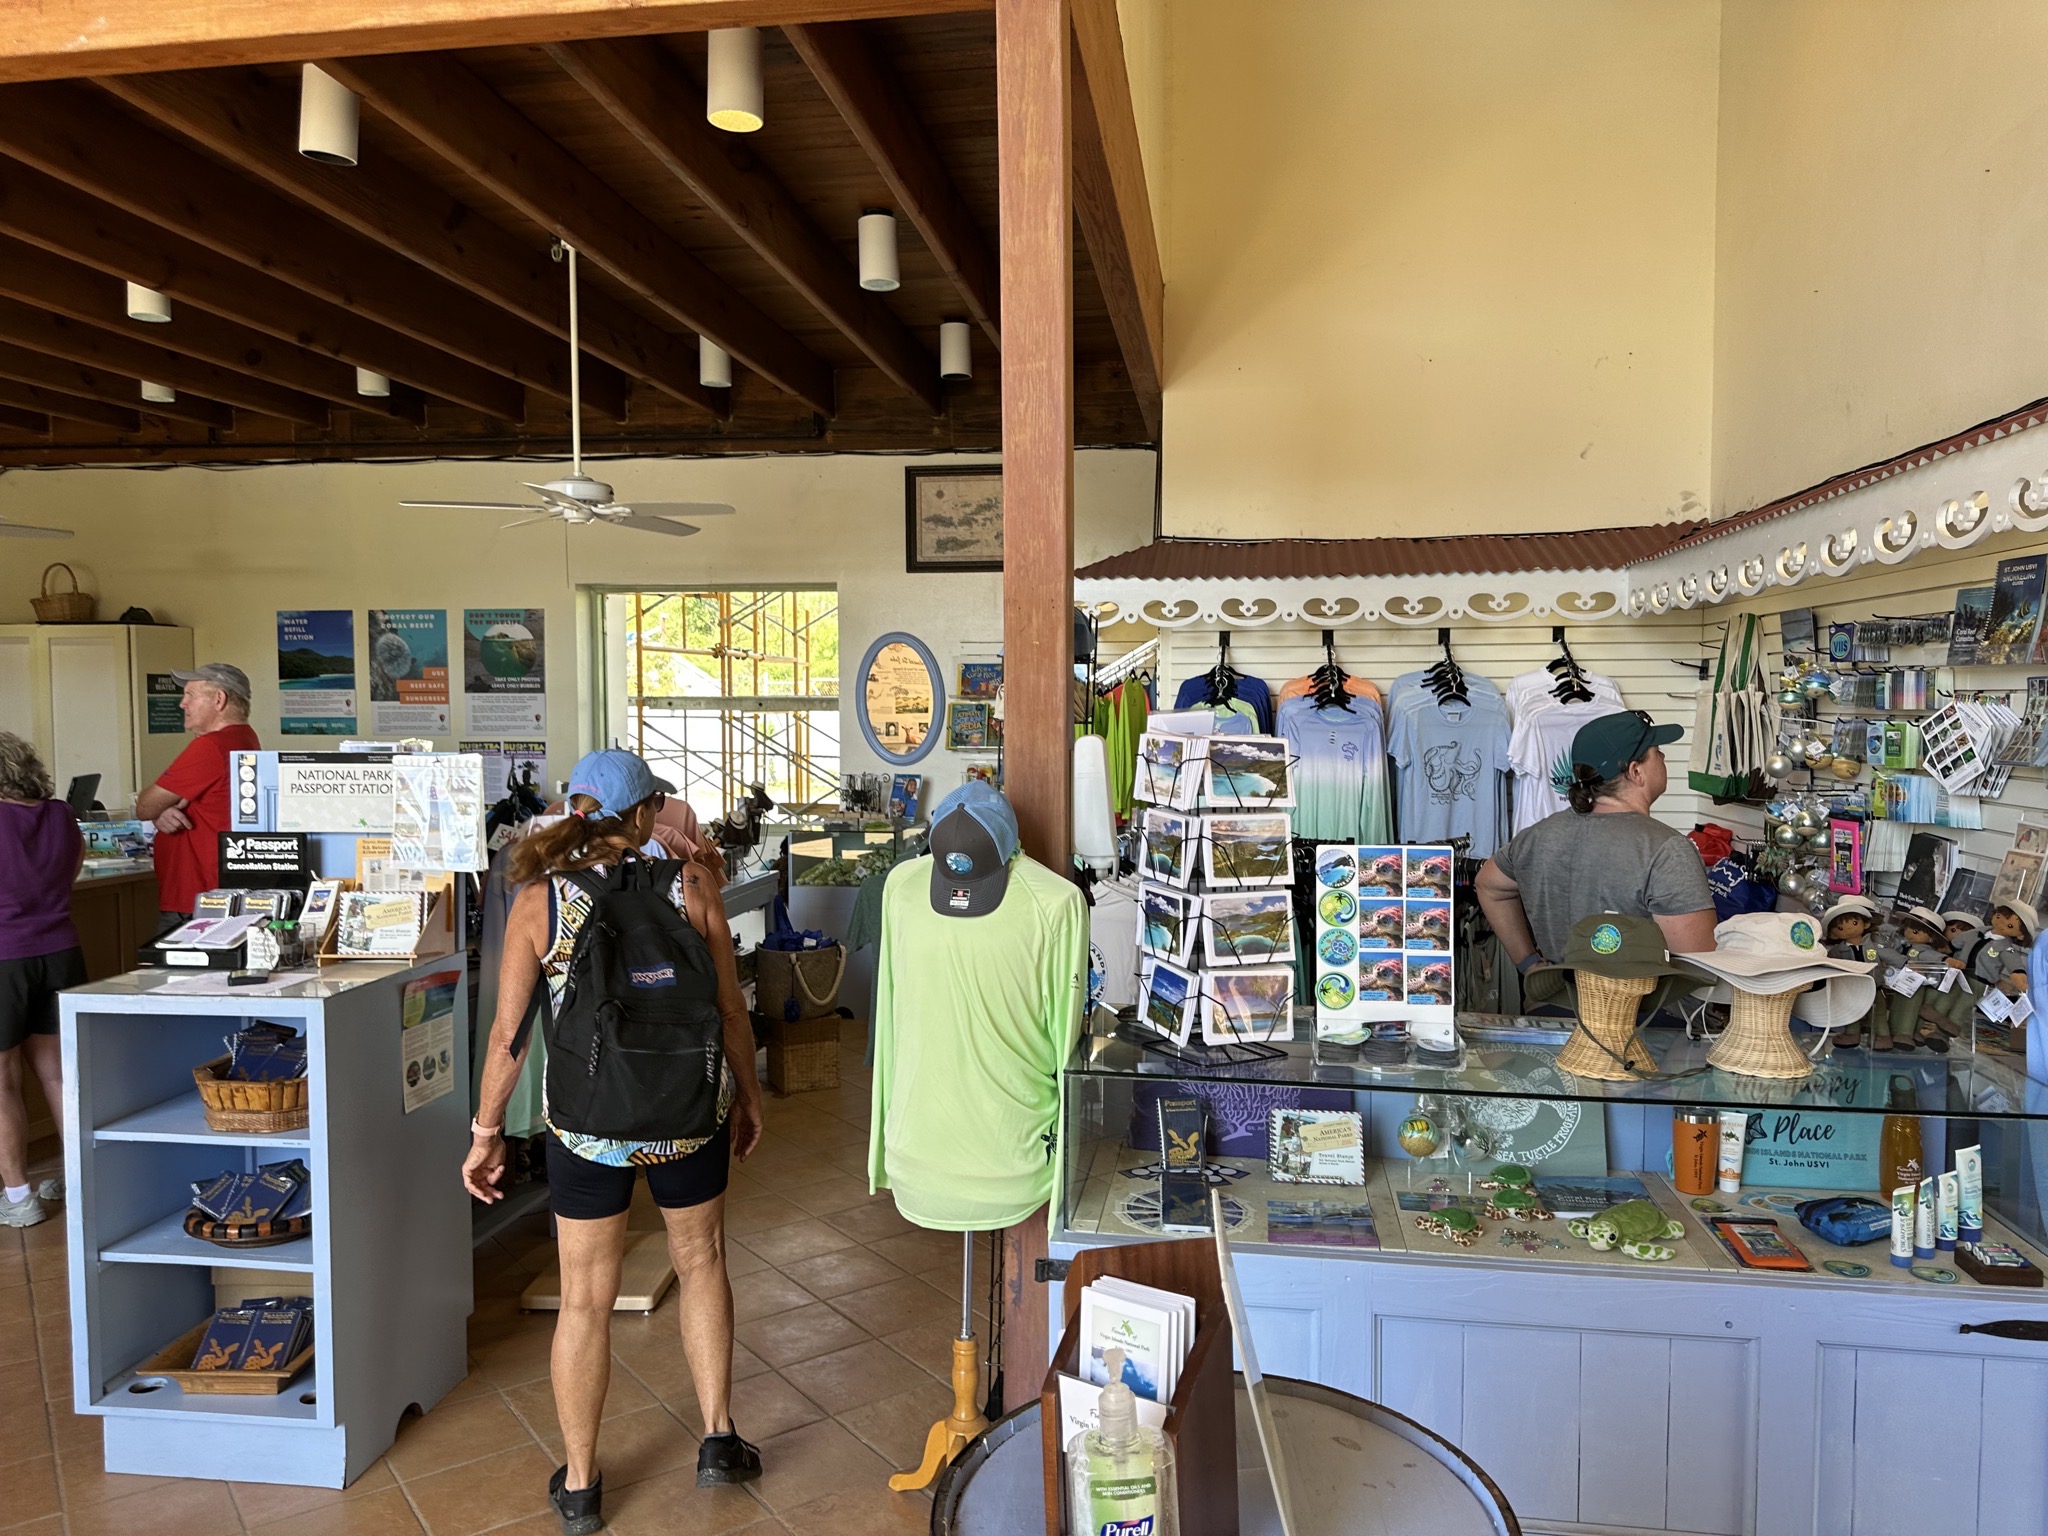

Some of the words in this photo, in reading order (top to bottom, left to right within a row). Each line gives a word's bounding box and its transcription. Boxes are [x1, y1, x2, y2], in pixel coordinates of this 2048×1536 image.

[2011, 565, 2025, 573] JOHN
[1833, 640, 1848, 652] VIIS
[297, 770, 360, 781] NATIONAL
[363, 770, 392, 781] PARK
[290, 783, 345, 794] PASSPORT
[349, 783, 393, 794] STATIO
[246, 838, 299, 852] Passport
[227, 862, 272, 870] Cancellation
[273, 862, 299, 871] Station
[632, 968, 674, 984] JANSPORT
[1320, 1126, 1352, 1136] AMERICA'S
[1773, 1112, 1836, 1145] Place
[1496, 1150, 1517, 1161] SEA
[1518, 1141, 1557, 1161] TURTLE
[1760, 1149, 1797, 1158] ISLANDS
[1798, 1151, 1842, 1161] NATIONAL
[1844, 1153, 1868, 1162] PARK
[1769, 1158, 1782, 1166] St.
[1784, 1159, 1805, 1168] John
[1807, 1160, 1830, 1169] USVI
[1069, 1415, 1089, 1429] Virgin
[1106, 1520, 1149, 1536] Purell
